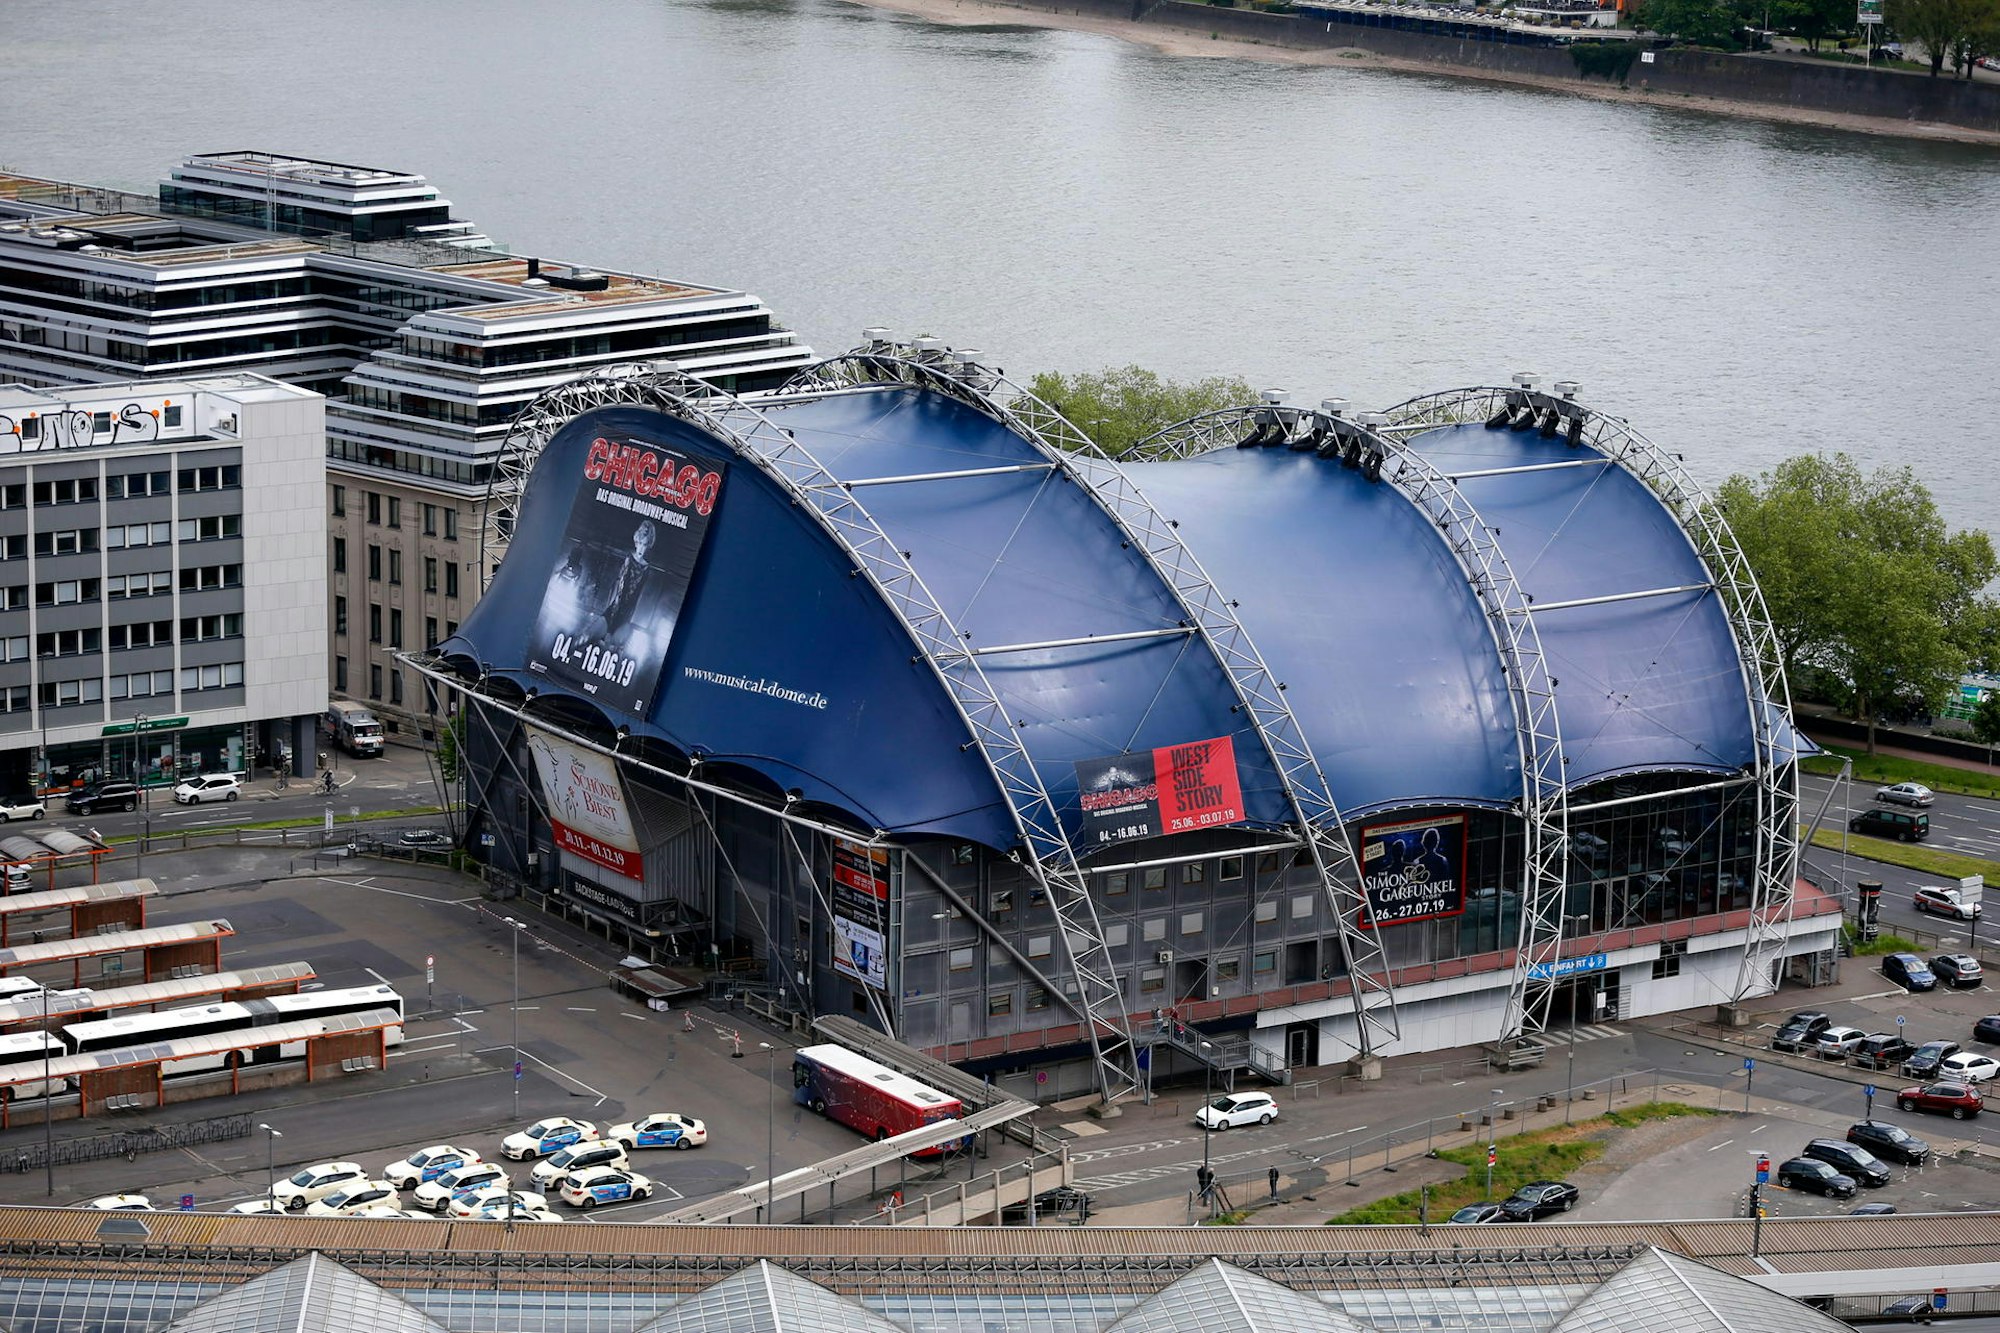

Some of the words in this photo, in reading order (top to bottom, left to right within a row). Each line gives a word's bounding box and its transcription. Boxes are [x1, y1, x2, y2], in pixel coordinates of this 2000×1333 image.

[584, 437, 721, 516] CHICAGO
[684, 667, 828, 709] www.musical-dome.de
[1171, 743, 1211, 769] WEST
[1173, 766, 1206, 791] SIDE
[582, 790, 617, 821] BIEST
[1081, 784, 1158, 811] CHICAGO
[1176, 784, 1223, 812] STORY
[1366, 873, 1409, 891] SIMON
[1379, 879, 1456, 902] GARFUNKEL
